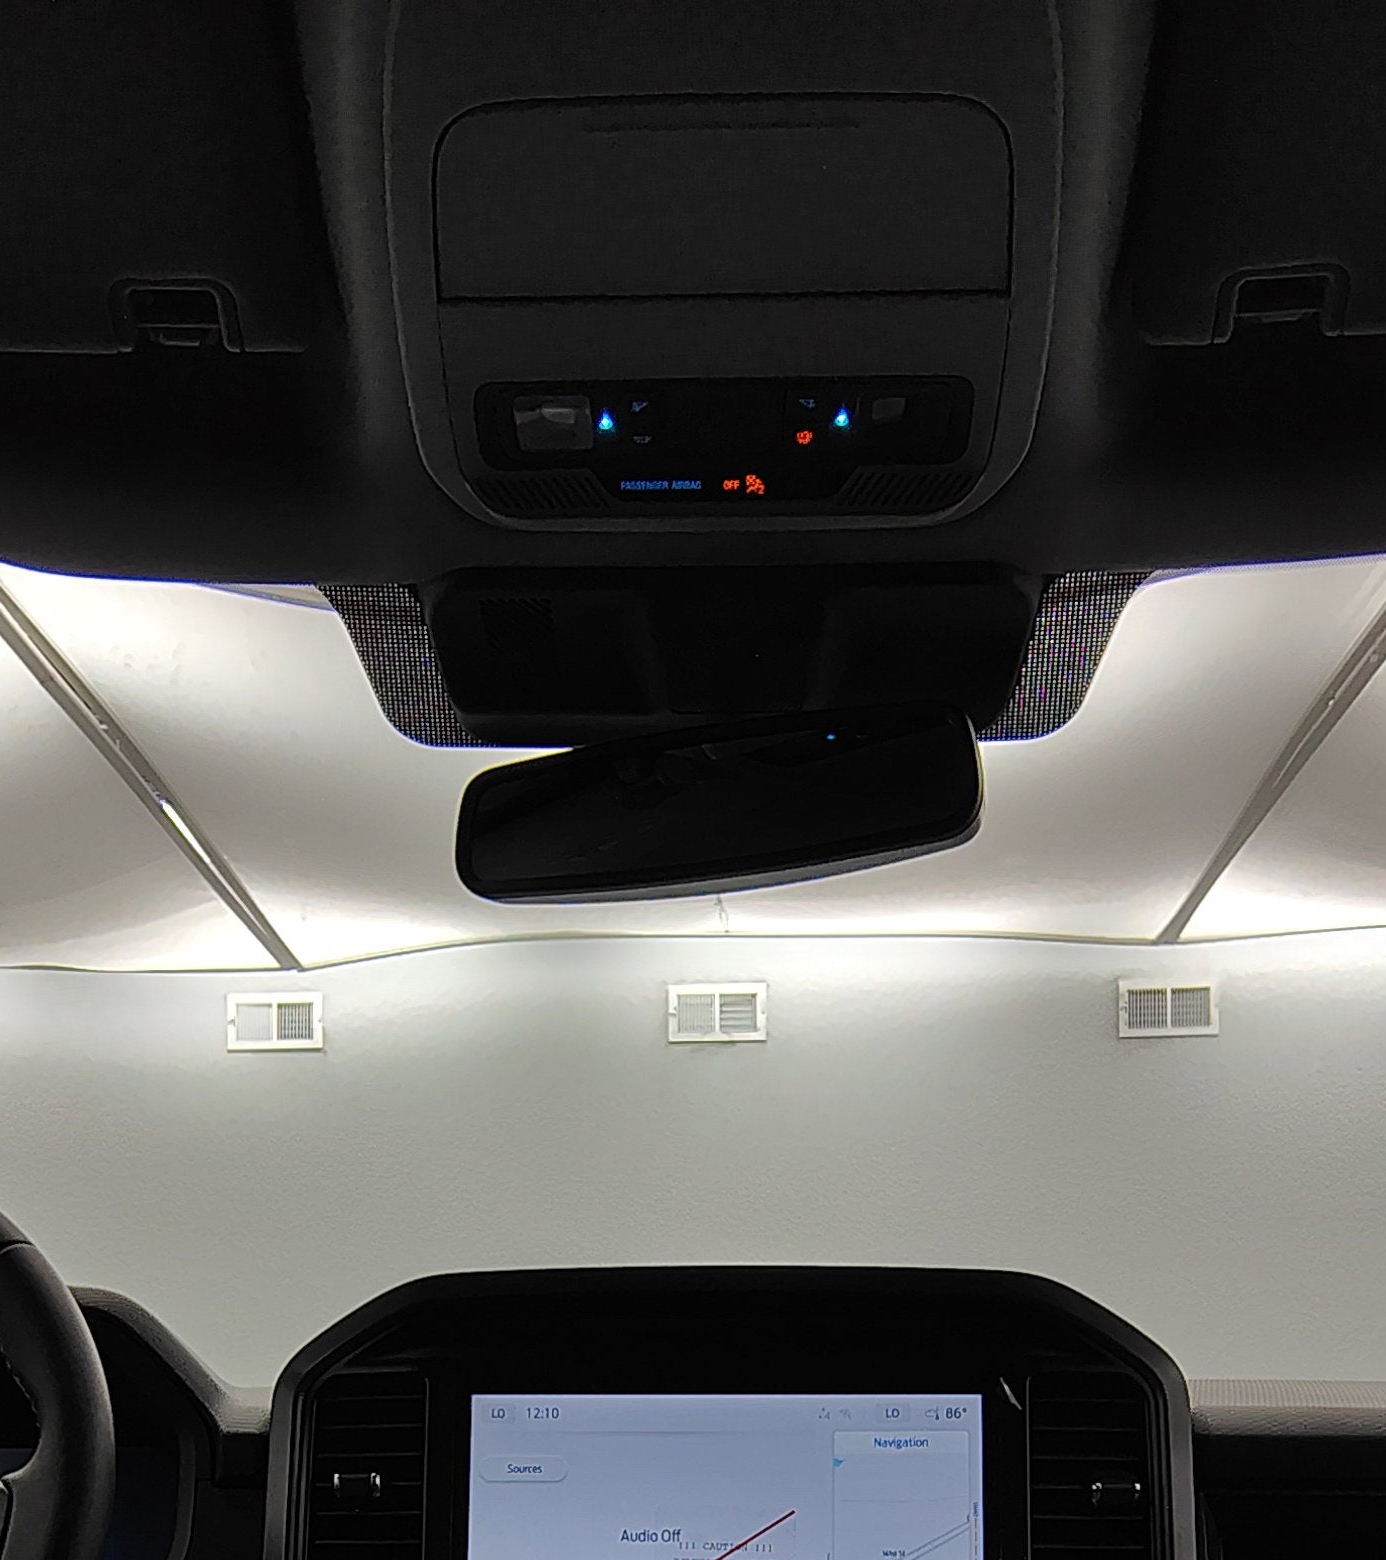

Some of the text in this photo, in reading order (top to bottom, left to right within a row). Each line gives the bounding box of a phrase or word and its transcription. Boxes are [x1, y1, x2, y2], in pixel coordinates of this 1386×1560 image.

[620, 480, 702, 490] PASSENGER AIRBAG
[722, 479, 740, 491] OFF
[491, 1408, 506, 1419] LO
[525, 1406, 560, 1420] 12:10
[885, 1408, 900, 1419] LO
[945, 1406, 968, 1420] 86°
[873, 1436, 929, 1450] Navigation
[506, 1463, 543, 1475] Sources
[620, 1529, 682, 1543] Audio Off
[702, 1542, 748, 1552] CAUTIN
